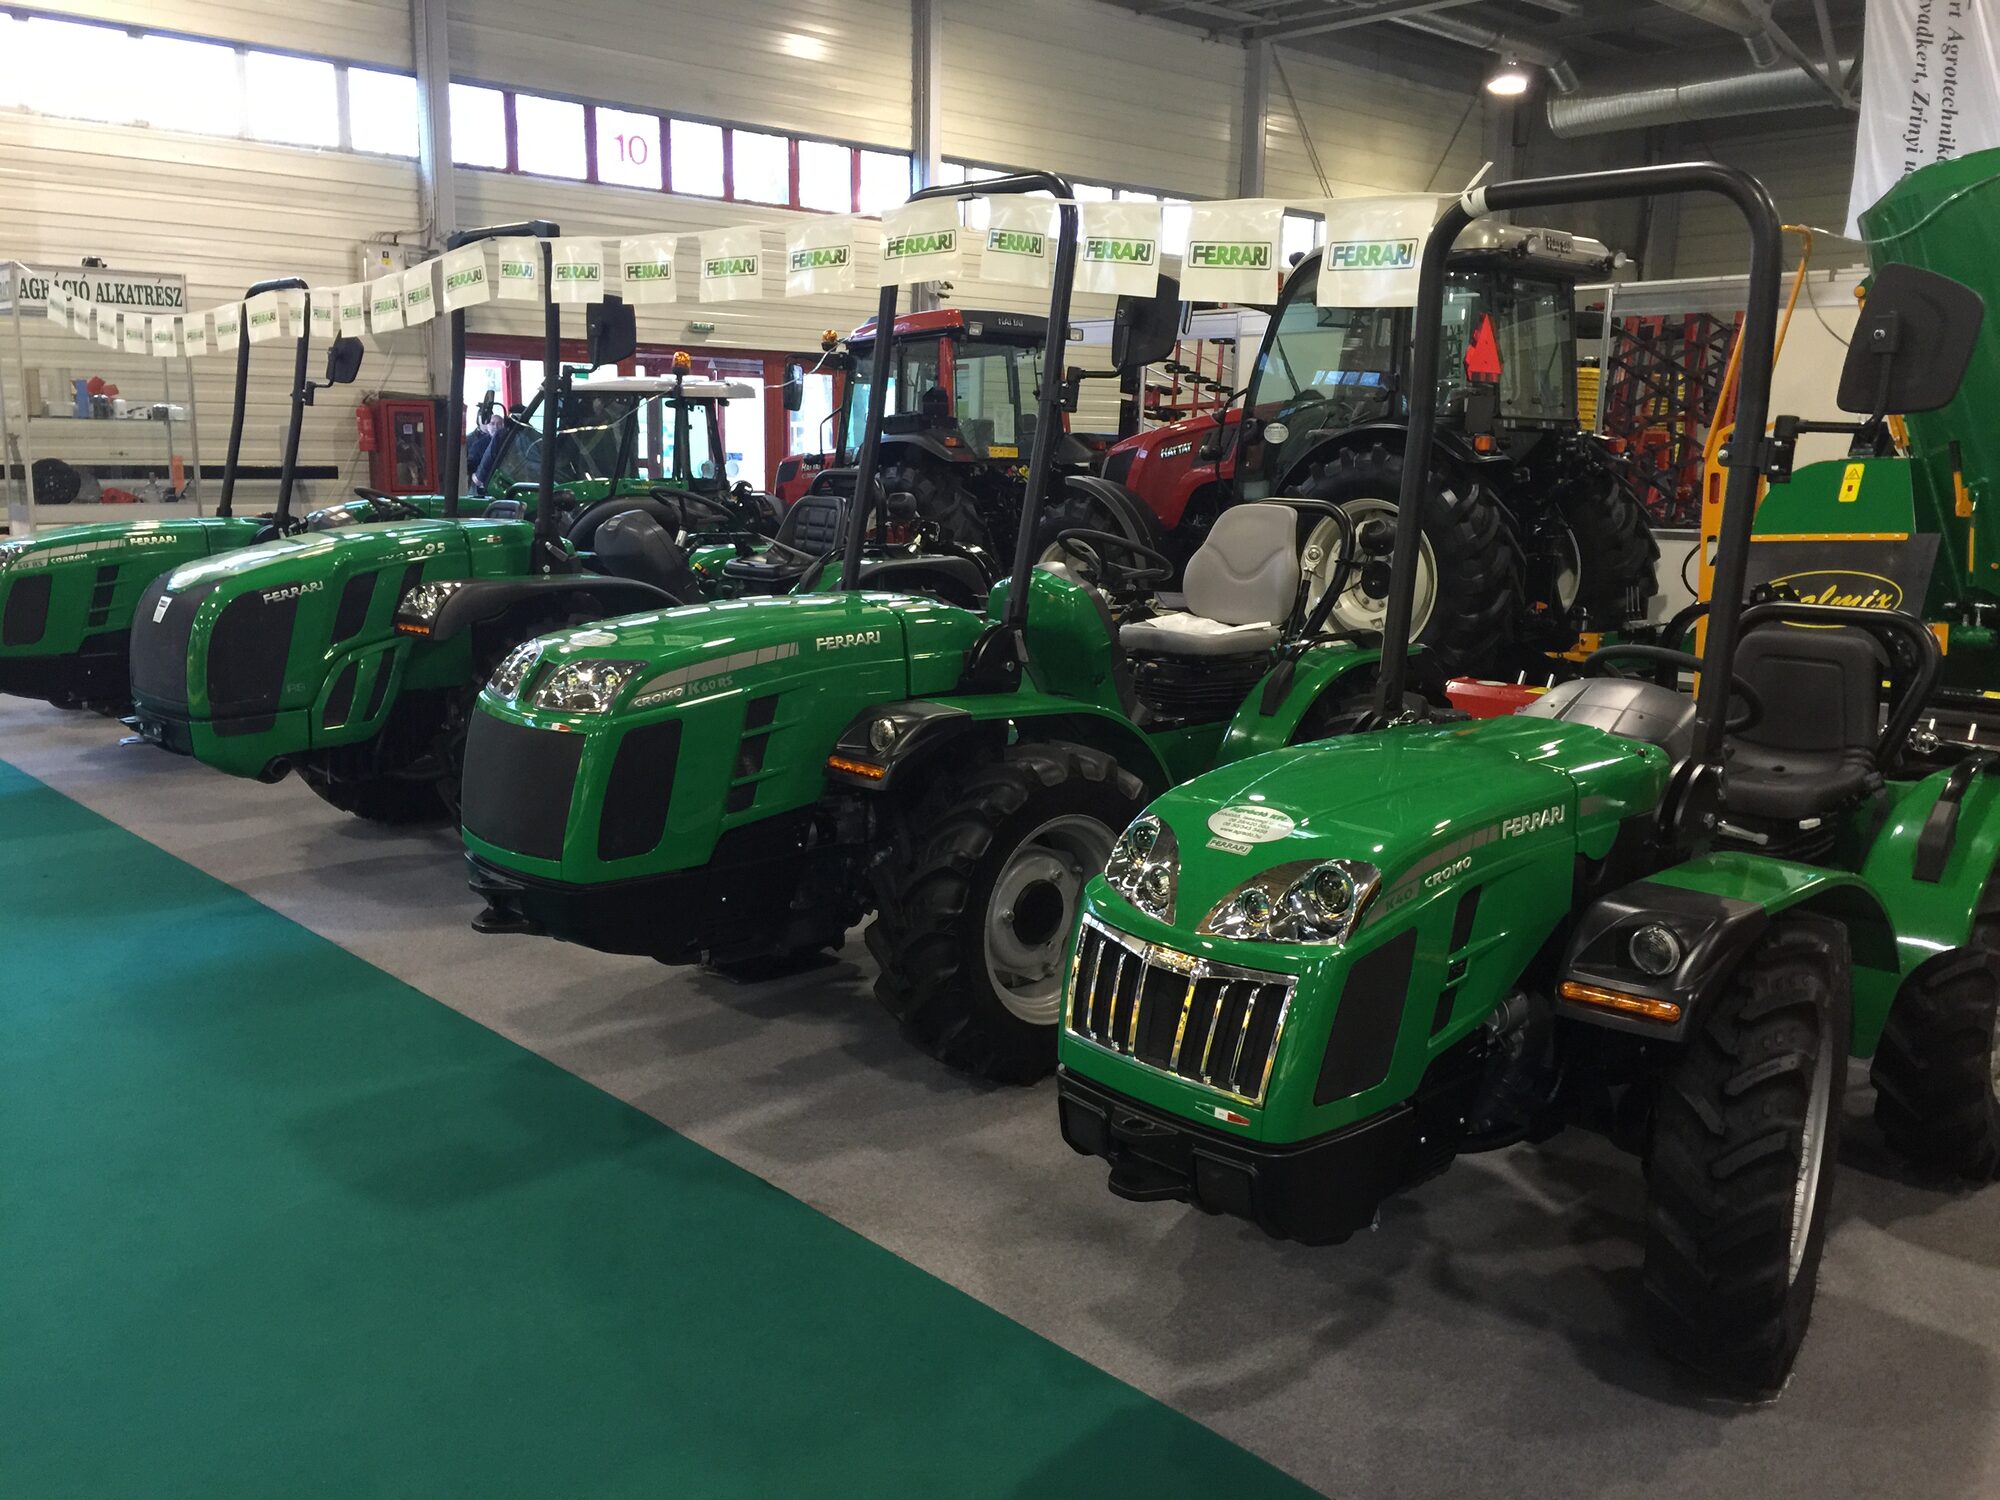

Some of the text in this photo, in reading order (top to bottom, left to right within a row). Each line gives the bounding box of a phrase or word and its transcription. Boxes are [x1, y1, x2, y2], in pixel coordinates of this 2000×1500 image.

[1902, 90, 1931, 154] Zrínyi
[614, 133, 648, 165] 10
[886, 233, 953, 257] FERRARI
[989, 231, 1042, 254] FERRARI
[1087, 239, 1151, 262] FERRARI
[791, 248, 848, 270] FERRARI
[1192, 243, 1268, 266] FERRARI
[1331, 242, 1413, 267] FERRARI
[446, 268, 482, 289] FERRARI
[501, 262, 533, 277] FERRARI
[556, 266, 598, 280] FERRARI
[626, 263, 670, 280] FERRARI
[706, 260, 755, 276] FERRARI
[96, 278, 183, 308] ALKATRÉSZ
[130, 535, 178, 546] FERRARI
[262, 580, 324, 605] FERRARI
[815, 630, 881, 652] FERRARI
[633, 686, 684, 708] CROMO
[1502, 803, 1567, 840] FERRARI
[1209, 838, 1249, 854] FERRARI
[1424, 855, 1473, 888] CROMO
